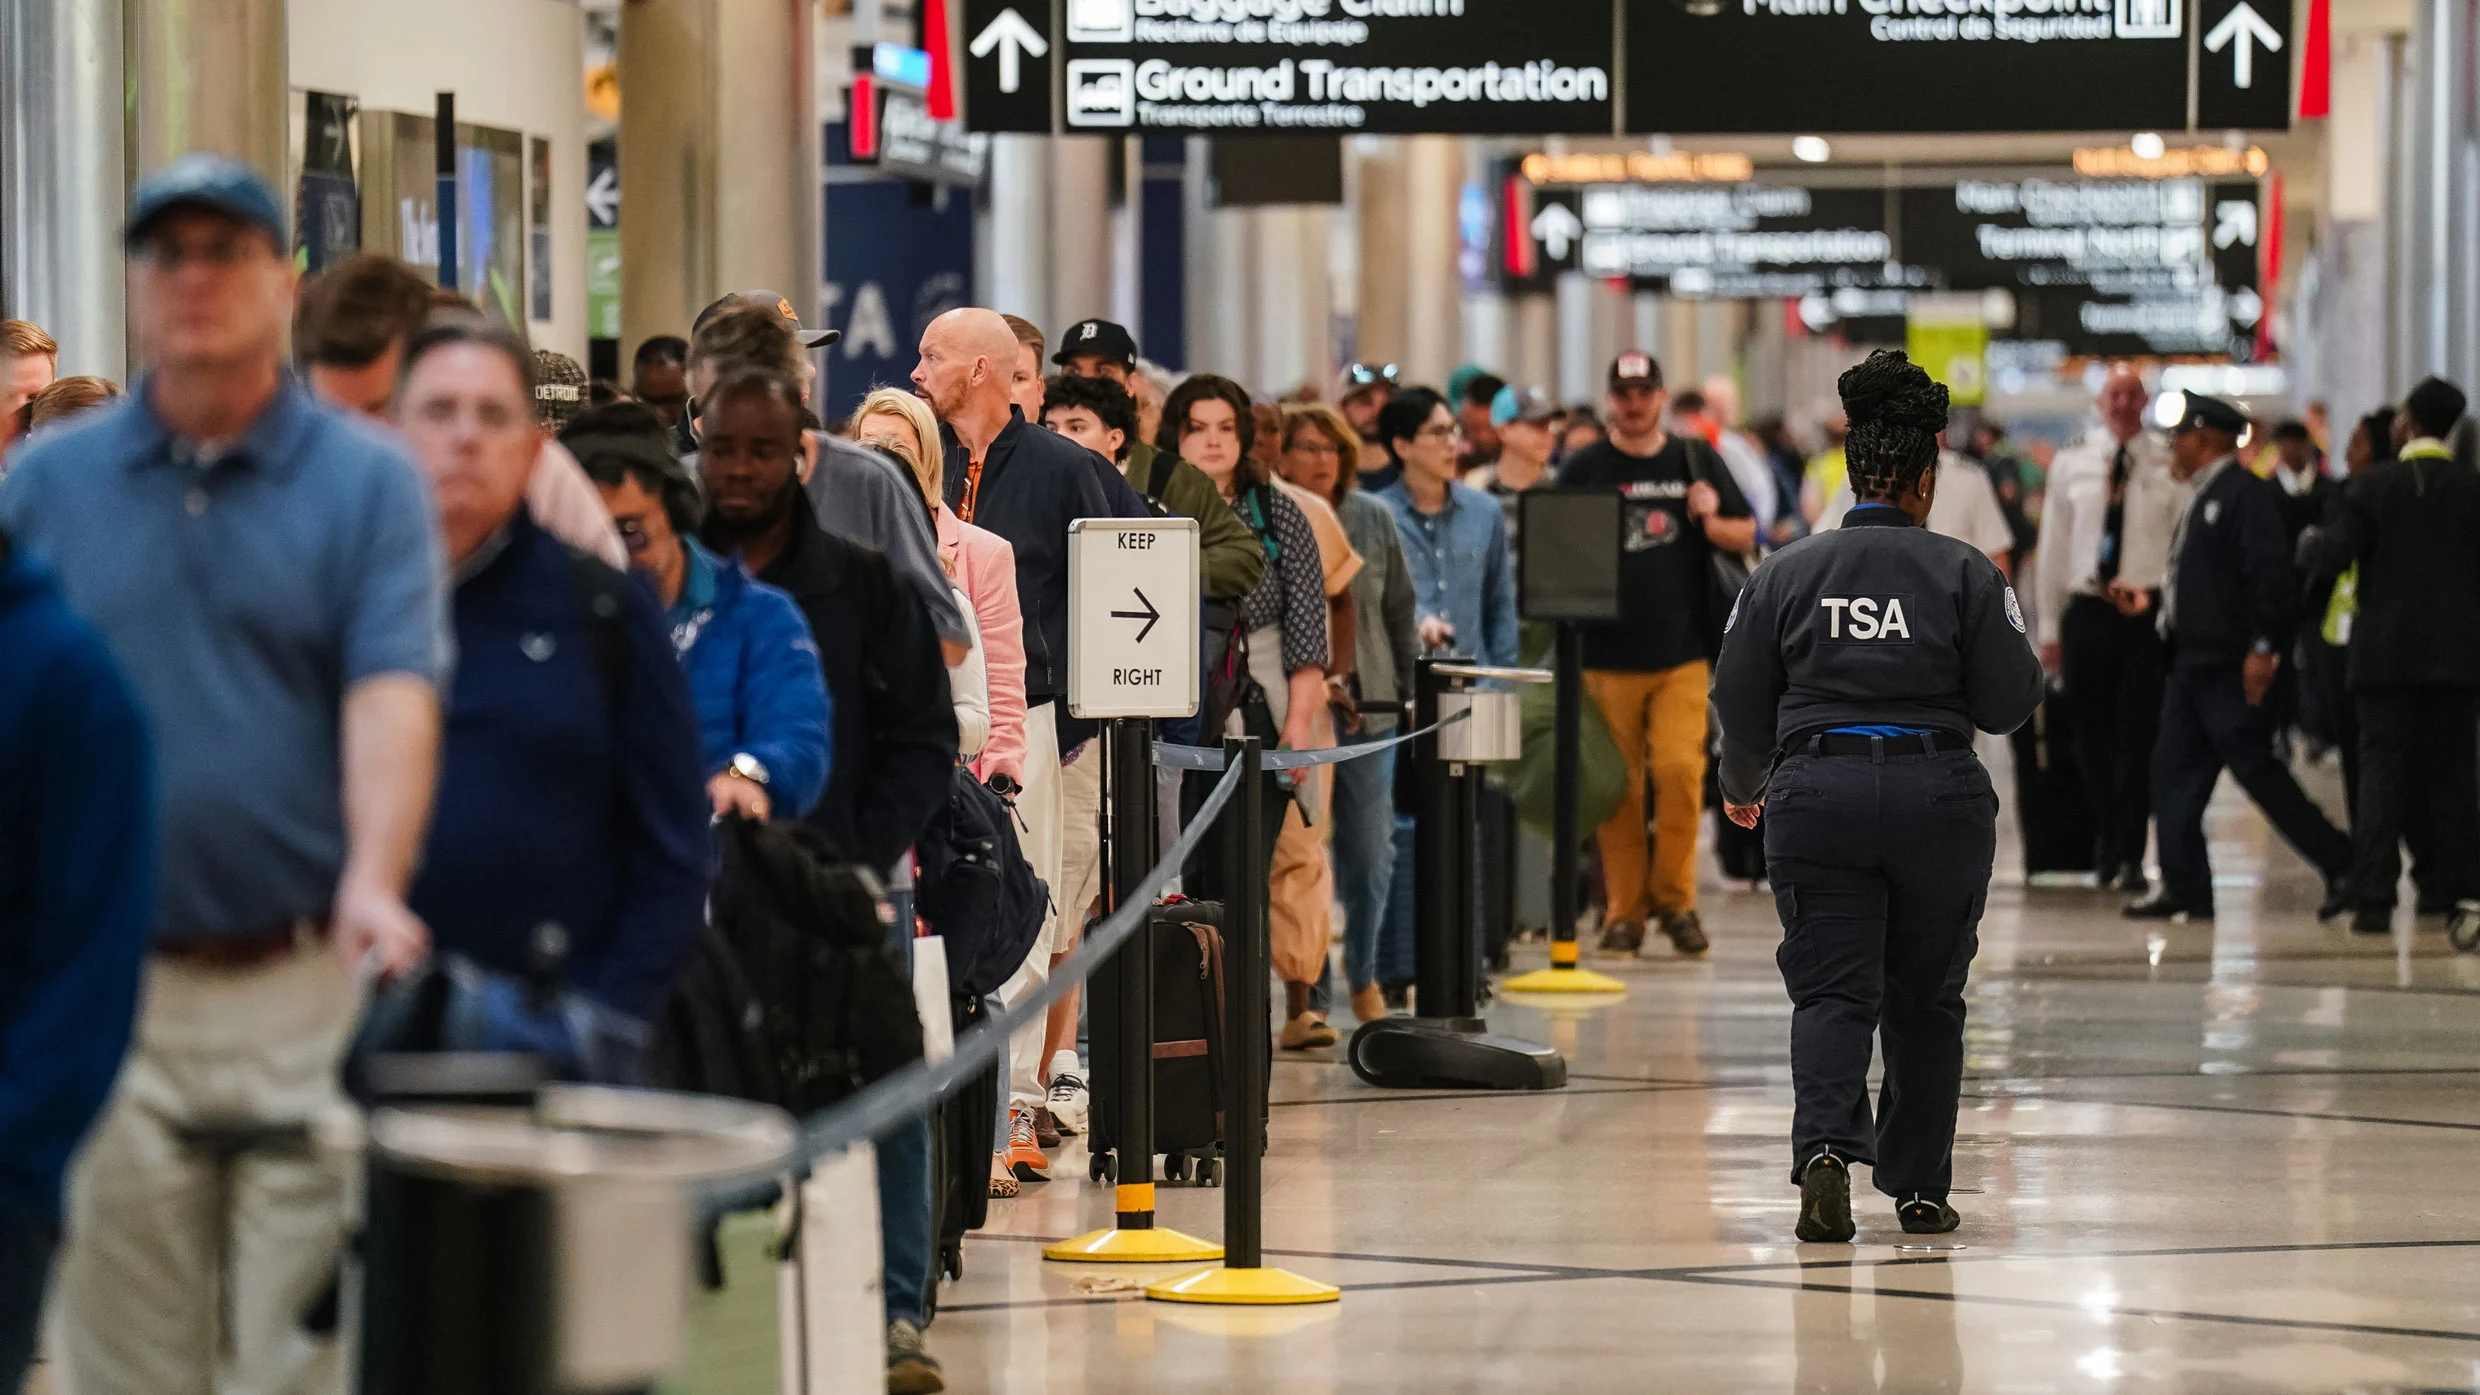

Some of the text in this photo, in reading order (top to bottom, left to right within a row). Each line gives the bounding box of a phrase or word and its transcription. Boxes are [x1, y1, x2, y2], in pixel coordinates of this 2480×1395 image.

[1870, 13, 2112, 43] Control de Seguridad
[1135, 58, 1607, 107] Ground Transportation
[535, 384, 580, 401] DETROIT
[1118, 532, 1156, 550] KEEP
[1821, 597, 1910, 641] TSA
[1112, 668, 1162, 686] RIGHT
